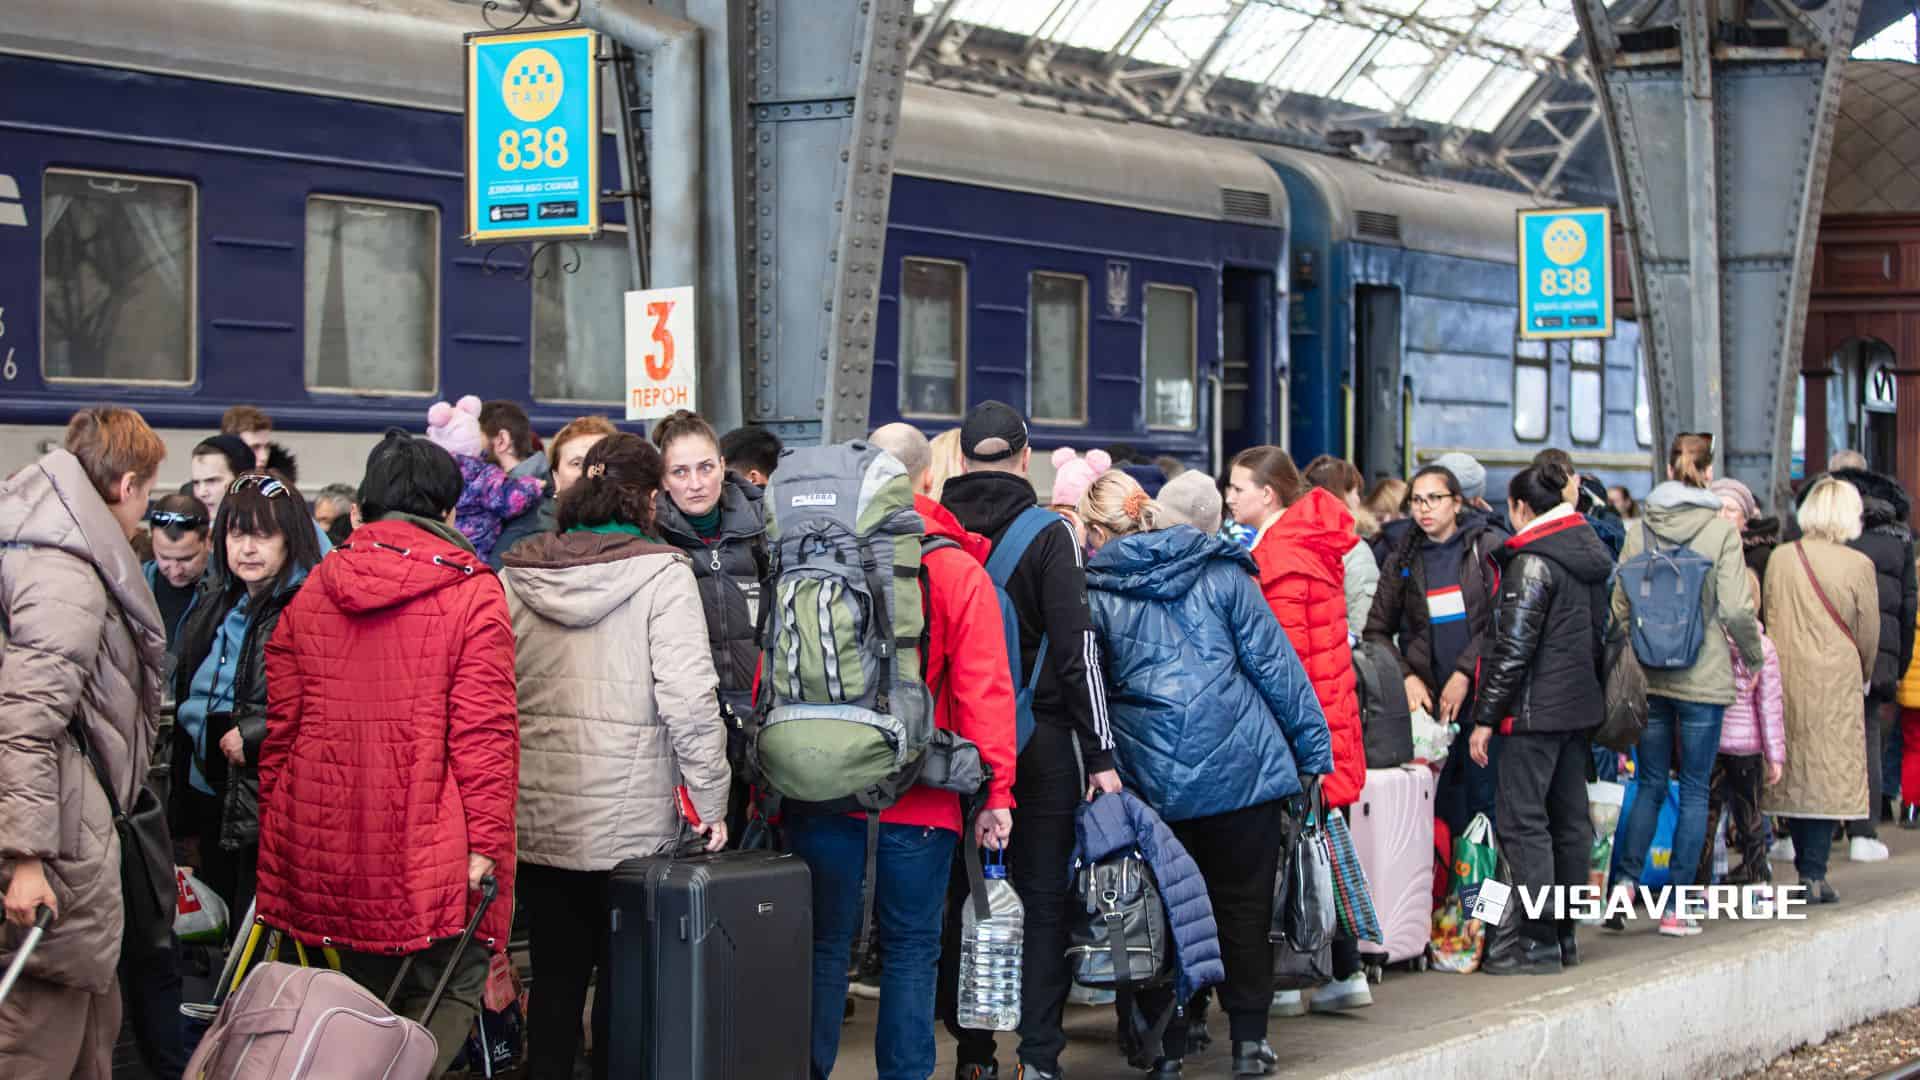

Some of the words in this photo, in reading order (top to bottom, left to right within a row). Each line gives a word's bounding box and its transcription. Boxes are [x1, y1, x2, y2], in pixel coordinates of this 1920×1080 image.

[512, 89, 555, 104] TAXI
[498, 127, 568, 171] 838
[1540, 267, 1592, 297] 838
[644, 301, 676, 382] 3
[632, 385, 688, 409] ПЕРОН
